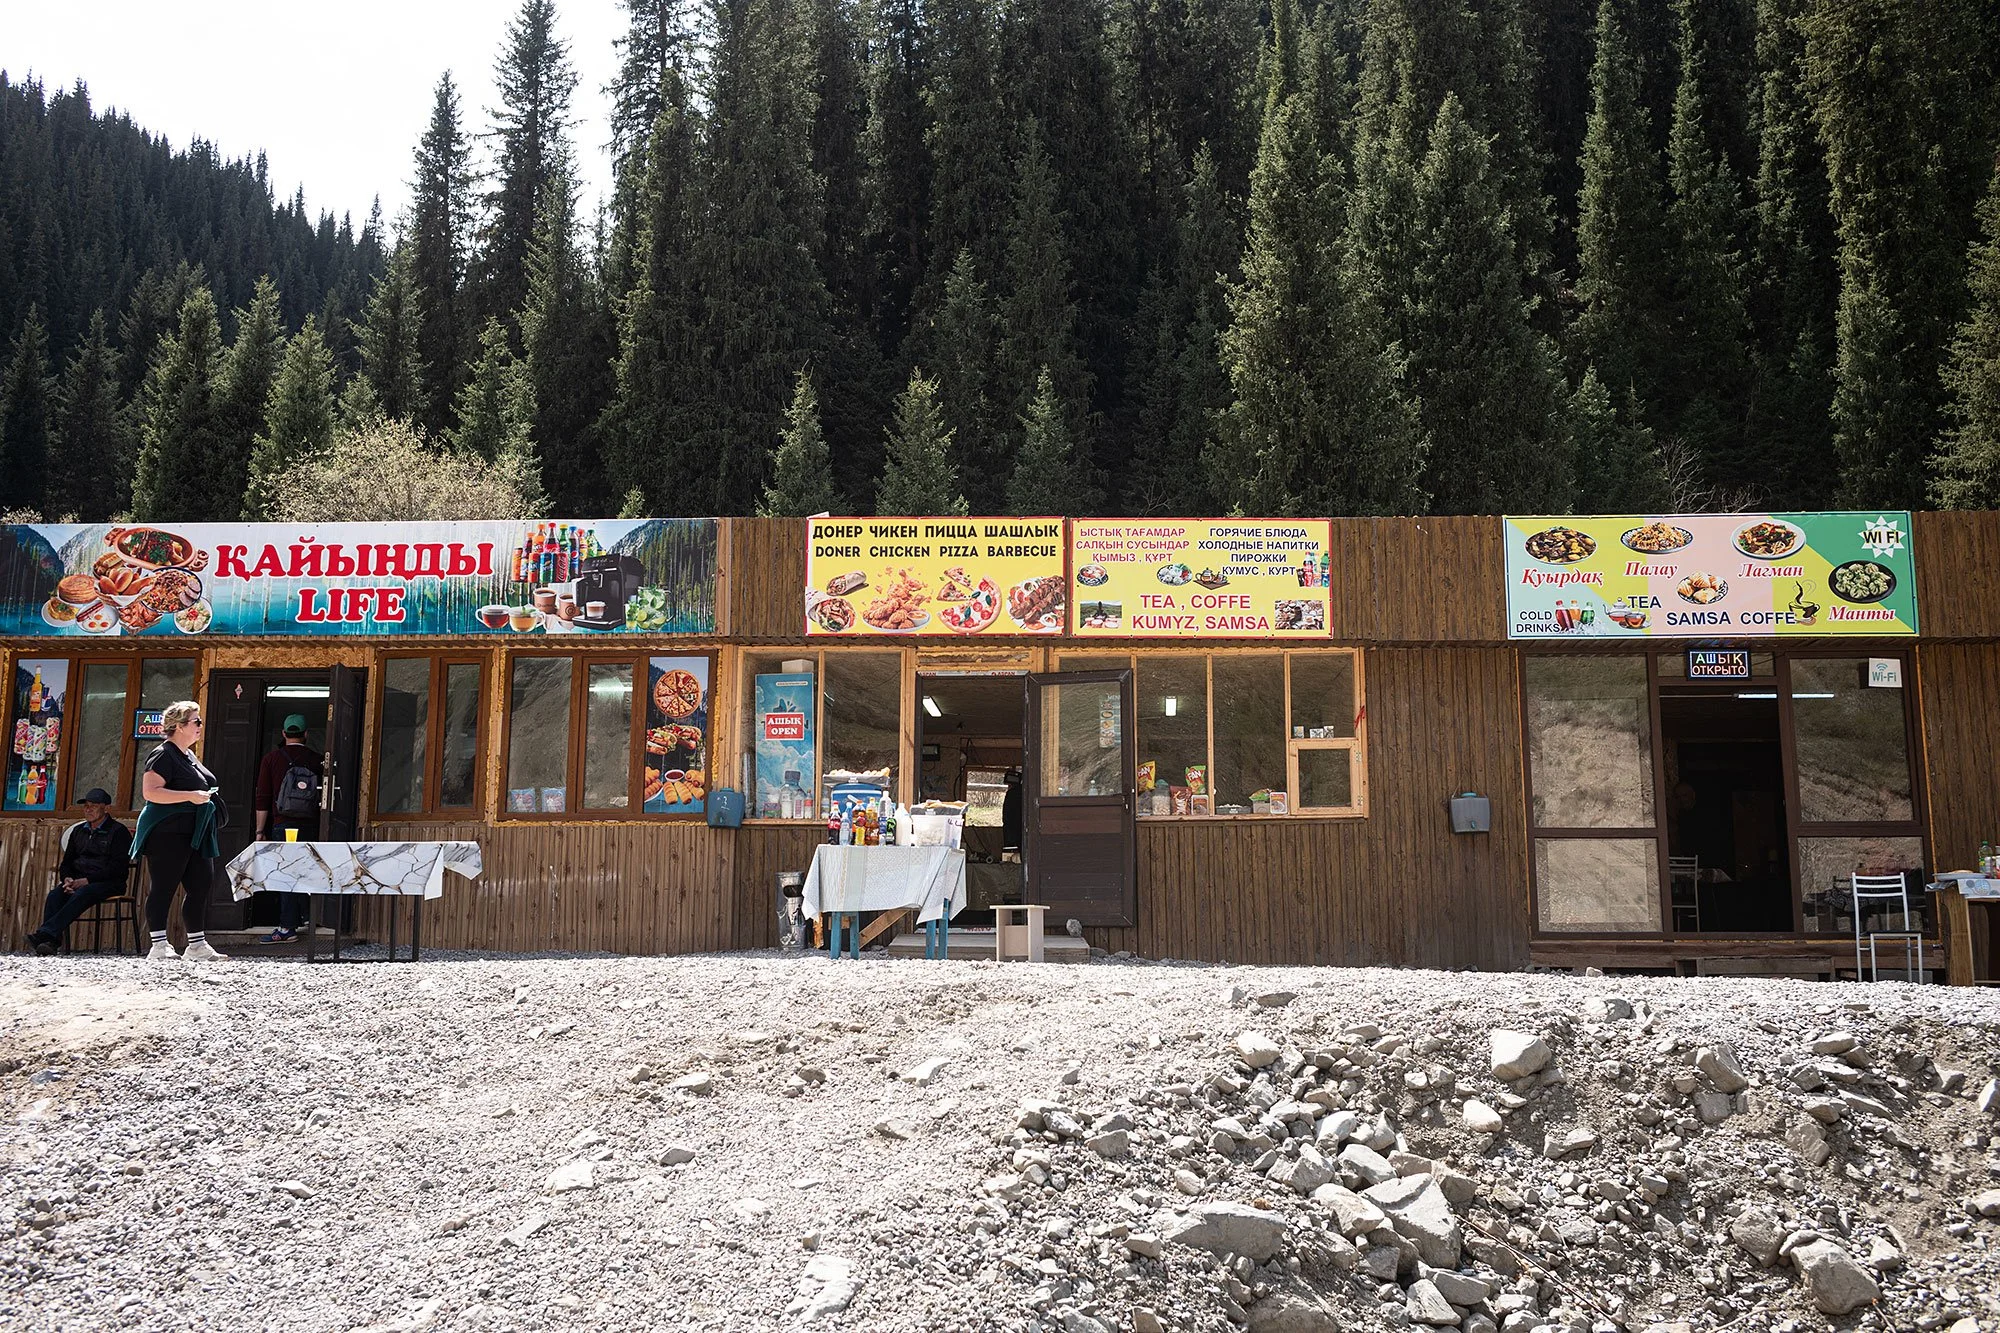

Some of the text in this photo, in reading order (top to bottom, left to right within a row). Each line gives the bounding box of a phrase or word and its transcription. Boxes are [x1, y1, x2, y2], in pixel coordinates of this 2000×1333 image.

[813, 525, 1059, 539] ДОНЕР ЧИКЕН ПИЦЦА ШАШЛЫК
[1080, 528, 1185, 537] ЫСТЫҚ ТАҒАМДАР
[1210, 528, 1307, 538] ГОРЯЧИЕ БЛЮДА
[1863, 531, 1899, 543] WI FI
[1076, 541, 1189, 550] САЛҚЫН СУСЫНДАР
[1198, 541, 1319, 551] ХОЛОДНЫЕ НАПИТКИ
[816, 546, 1056, 557] DONER CHICKEN PIZZA BARBECUE
[1093, 553, 1136, 563] ҚЫМЫЗ
[1145, 553, 1172, 563] ҚҰРТ
[1231, 554, 1286, 562] ПИРОЖКИ
[1222, 567, 1259, 575] КУМУС
[1268, 567, 1295, 575] КУРТ
[1625, 562, 1678, 578] Палау
[1738, 563, 1803, 577] Лагман
[296, 589, 405, 623] LIFE
[1140, 595, 1175, 608] TEA
[1191, 595, 1250, 608] COFFE
[1628, 596, 1661, 608] TEA
[1520, 611, 1552, 620] COLD
[1828, 606, 1895, 620] Манты
[1132, 616, 1269, 631] KUMYZ, SAMSA
[1667, 612, 1796, 626] SAMSA COFFE
[1516, 624, 1560, 632] DRINKS
[1695, 653, 1743, 665] АШЫҚ
[1692, 665, 1746, 675] ОТКРЫТО
[1871, 671, 1897, 682] Wi-Fi
